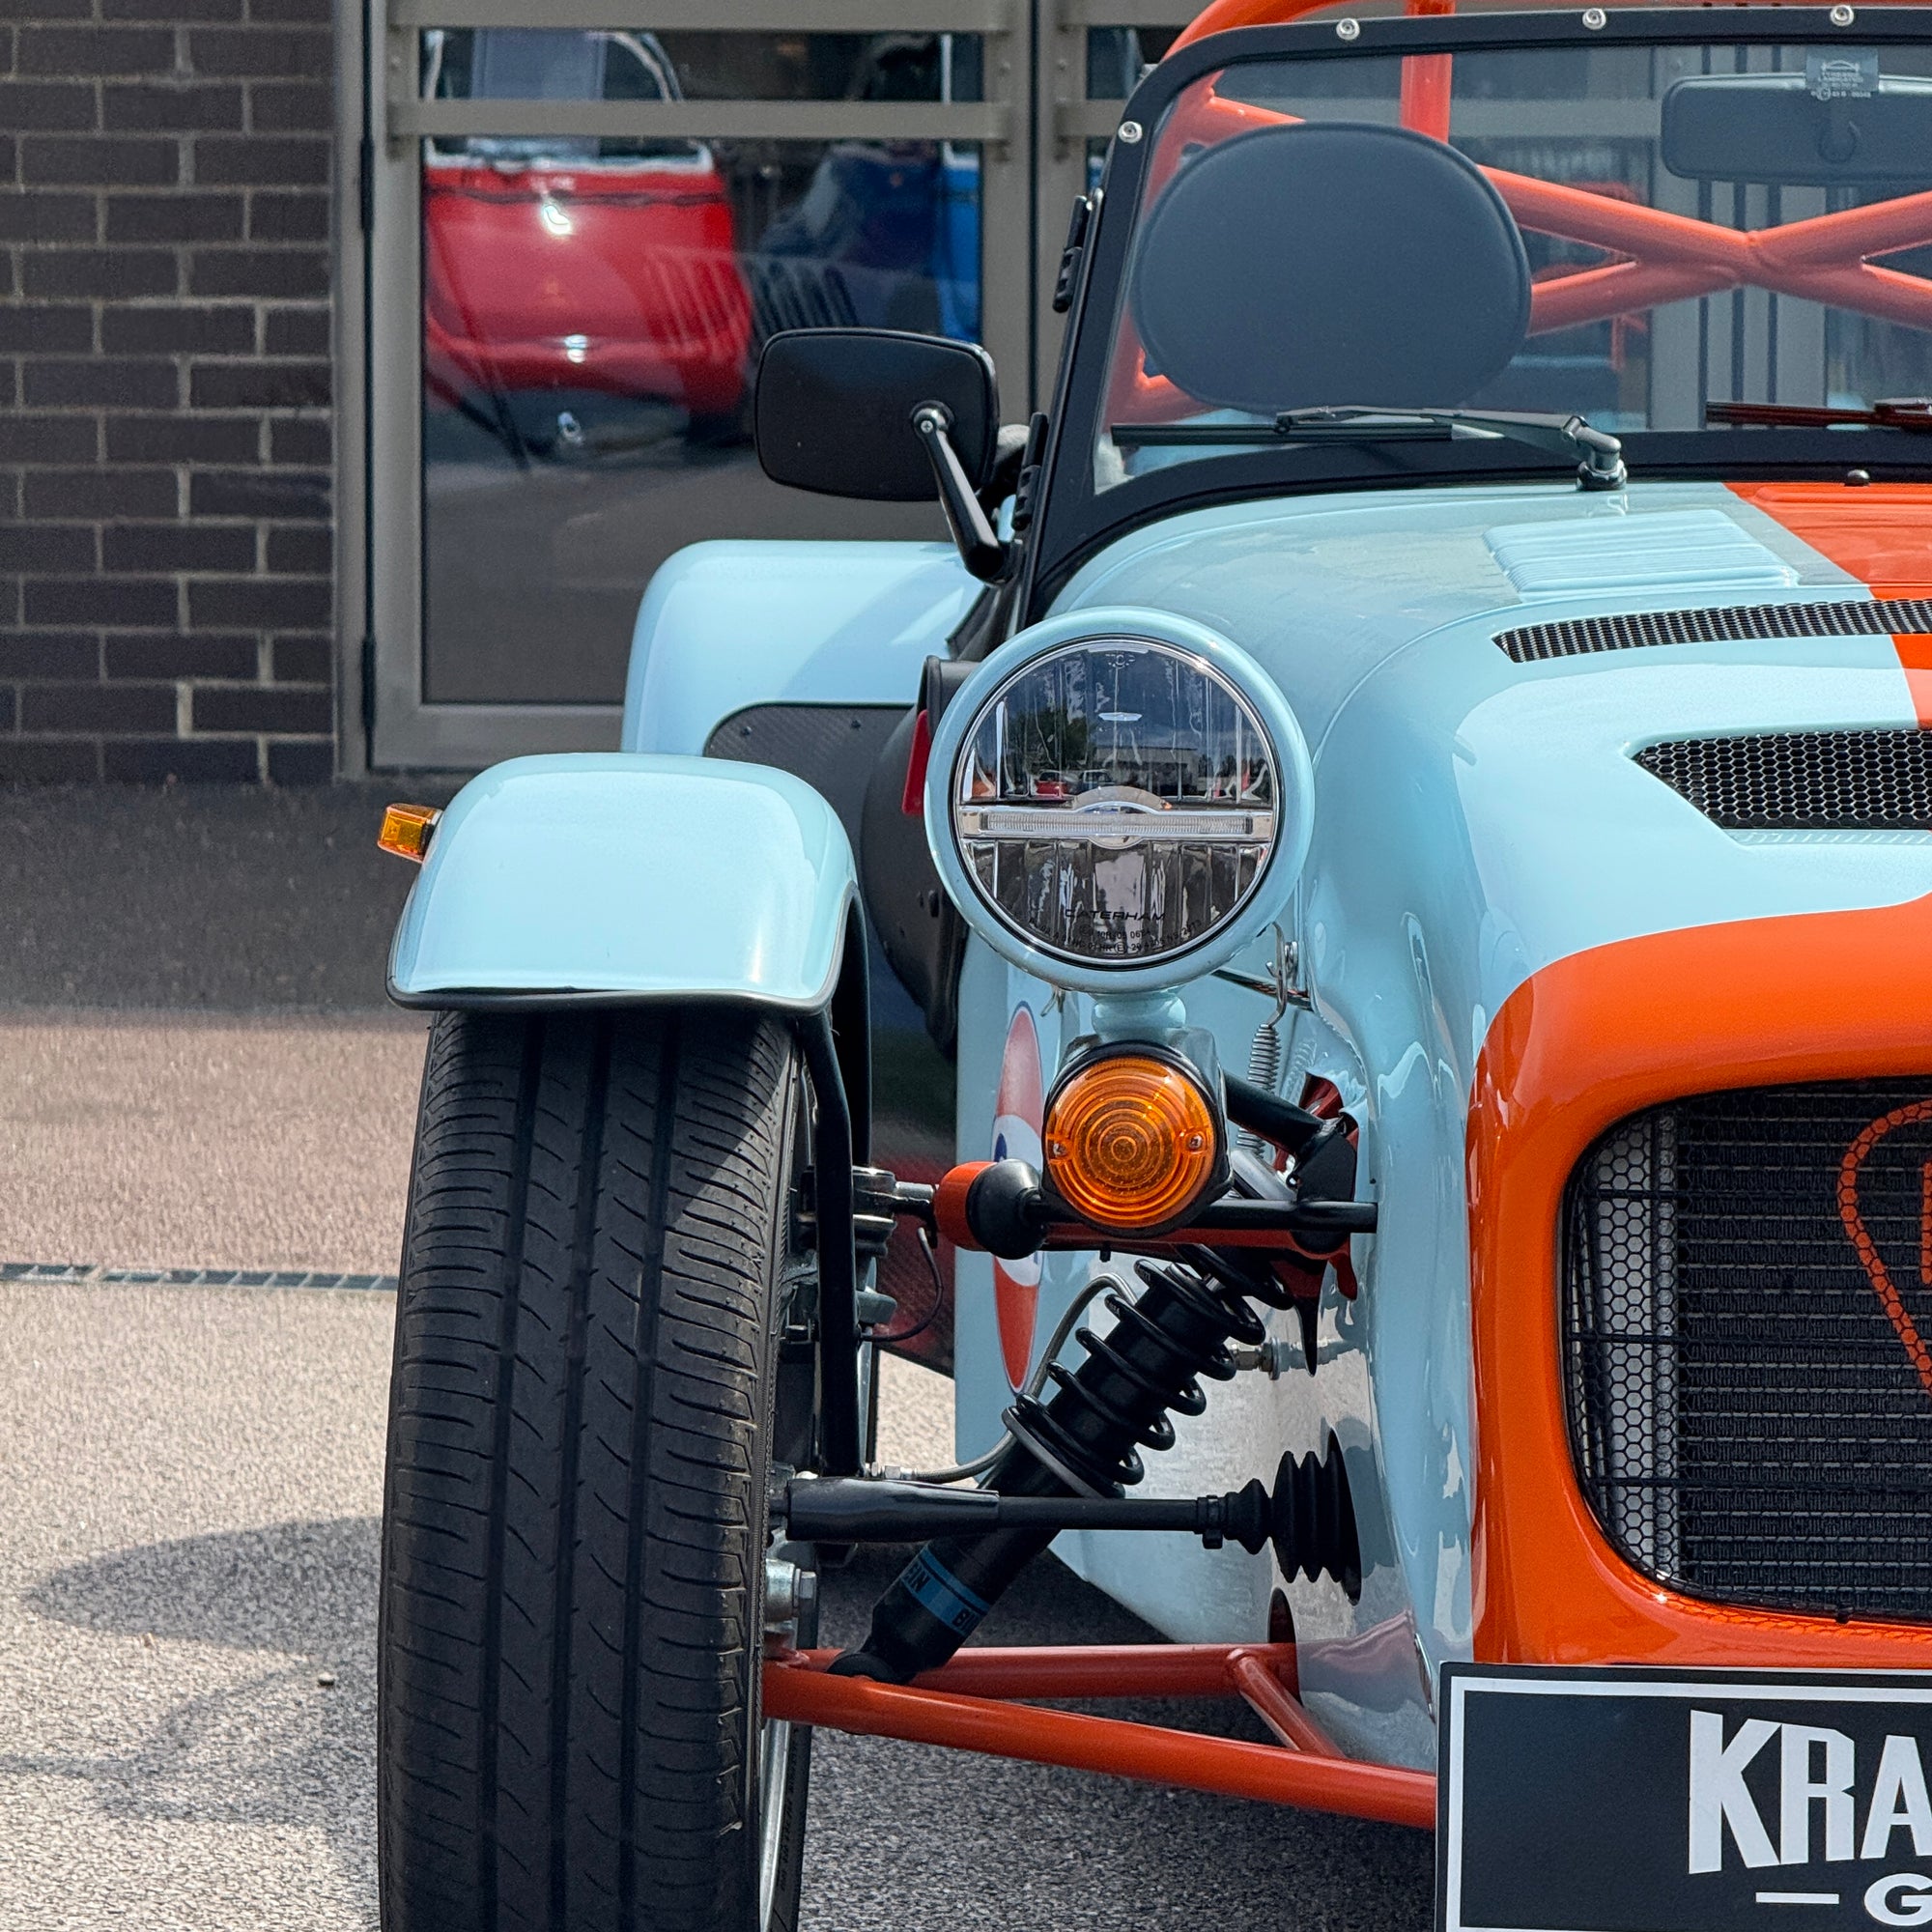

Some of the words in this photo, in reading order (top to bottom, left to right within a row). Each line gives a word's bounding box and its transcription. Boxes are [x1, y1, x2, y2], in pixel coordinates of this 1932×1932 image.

[1065, 908, 1166, 921] CATERHAM
[1689, 1709, 1932, 1874] KRA
[1863, 1872, 1932, 1926] G
